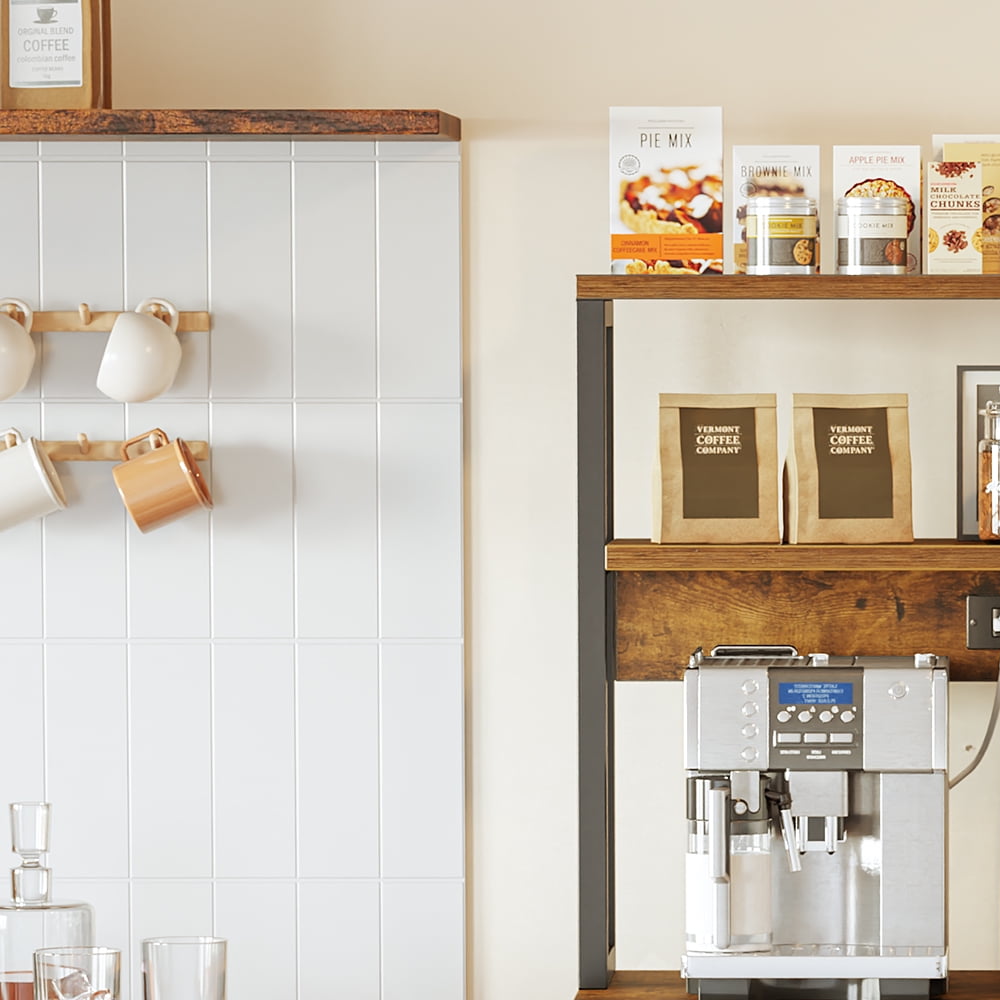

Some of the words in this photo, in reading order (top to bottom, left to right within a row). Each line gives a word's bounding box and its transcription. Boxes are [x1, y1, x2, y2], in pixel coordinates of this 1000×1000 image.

[23, 39, 70, 52] COFFEE
[640, 133, 661, 148] PIE
[668, 133, 692, 148] MIX
[848, 156, 873, 164] APPLE
[875, 156, 890, 164] PIE
[891, 156, 905, 164] MIX
[741, 166, 787, 178] BROWNIE
[793, 166, 813, 178] MIX
[697, 425, 741, 433] VERMONT
[830, 425, 873, 433] VERMONT
[696, 435, 741, 444] COFFEE
[830, 435, 873, 444] COFFEE
[696, 446, 742, 454] COMPANY
[830, 446, 875, 454] COMPANY
